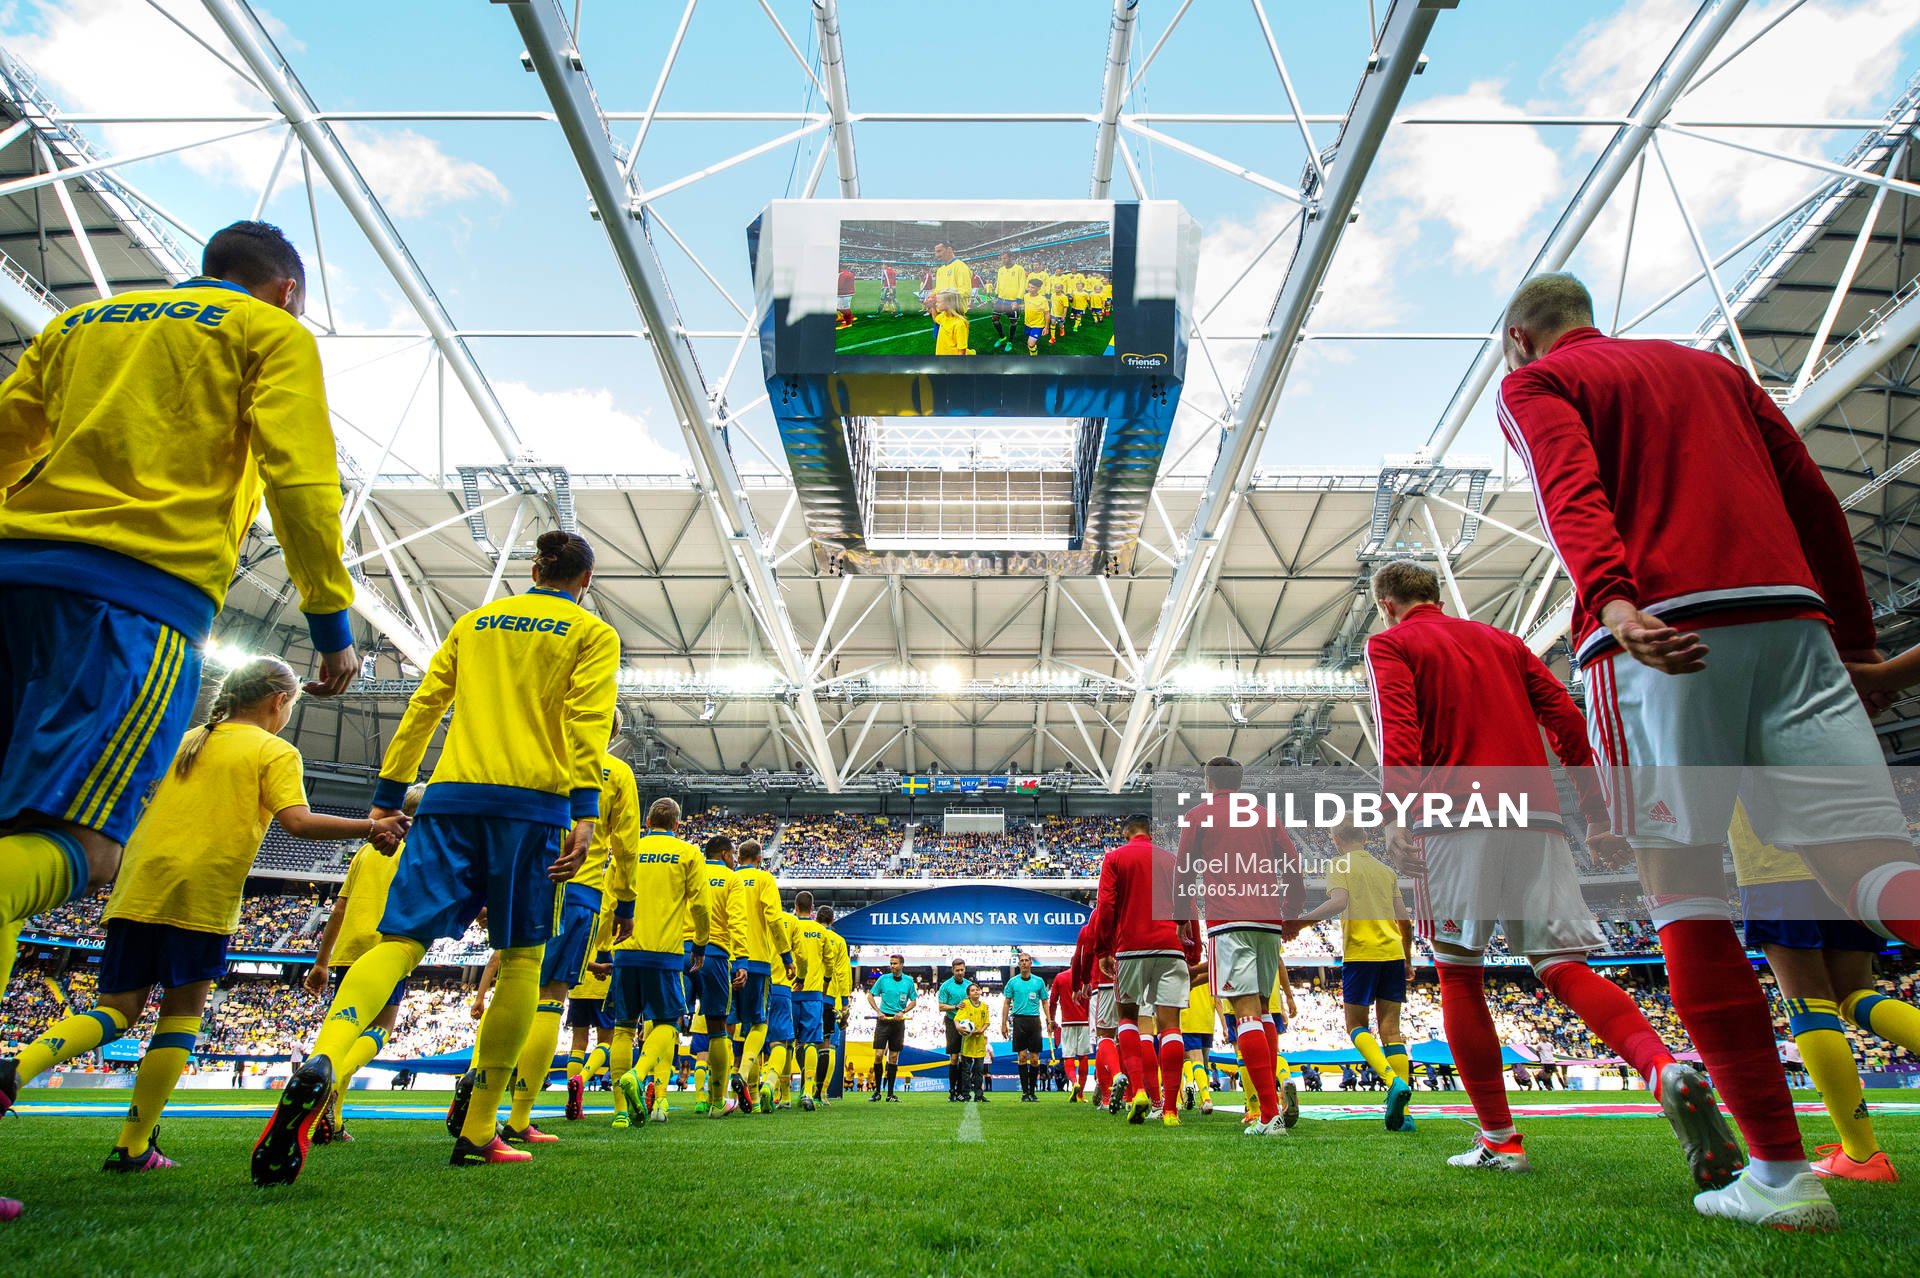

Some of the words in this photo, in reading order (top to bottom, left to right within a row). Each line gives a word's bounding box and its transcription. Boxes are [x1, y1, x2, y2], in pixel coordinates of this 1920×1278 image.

[61, 301, 230, 334] SVERIGE
[1128, 356, 1161, 366] friends
[475, 614, 571, 636] SVERIGE
[638, 853, 680, 864] ERIGE
[870, 912, 984, 925] TILLSAMMANS
[988, 912, 1018, 925] TAR
[1023, 912, 1039, 925] VI
[1043, 912, 1086, 926] GULD
[76, 938, 106, 948] 00:00
